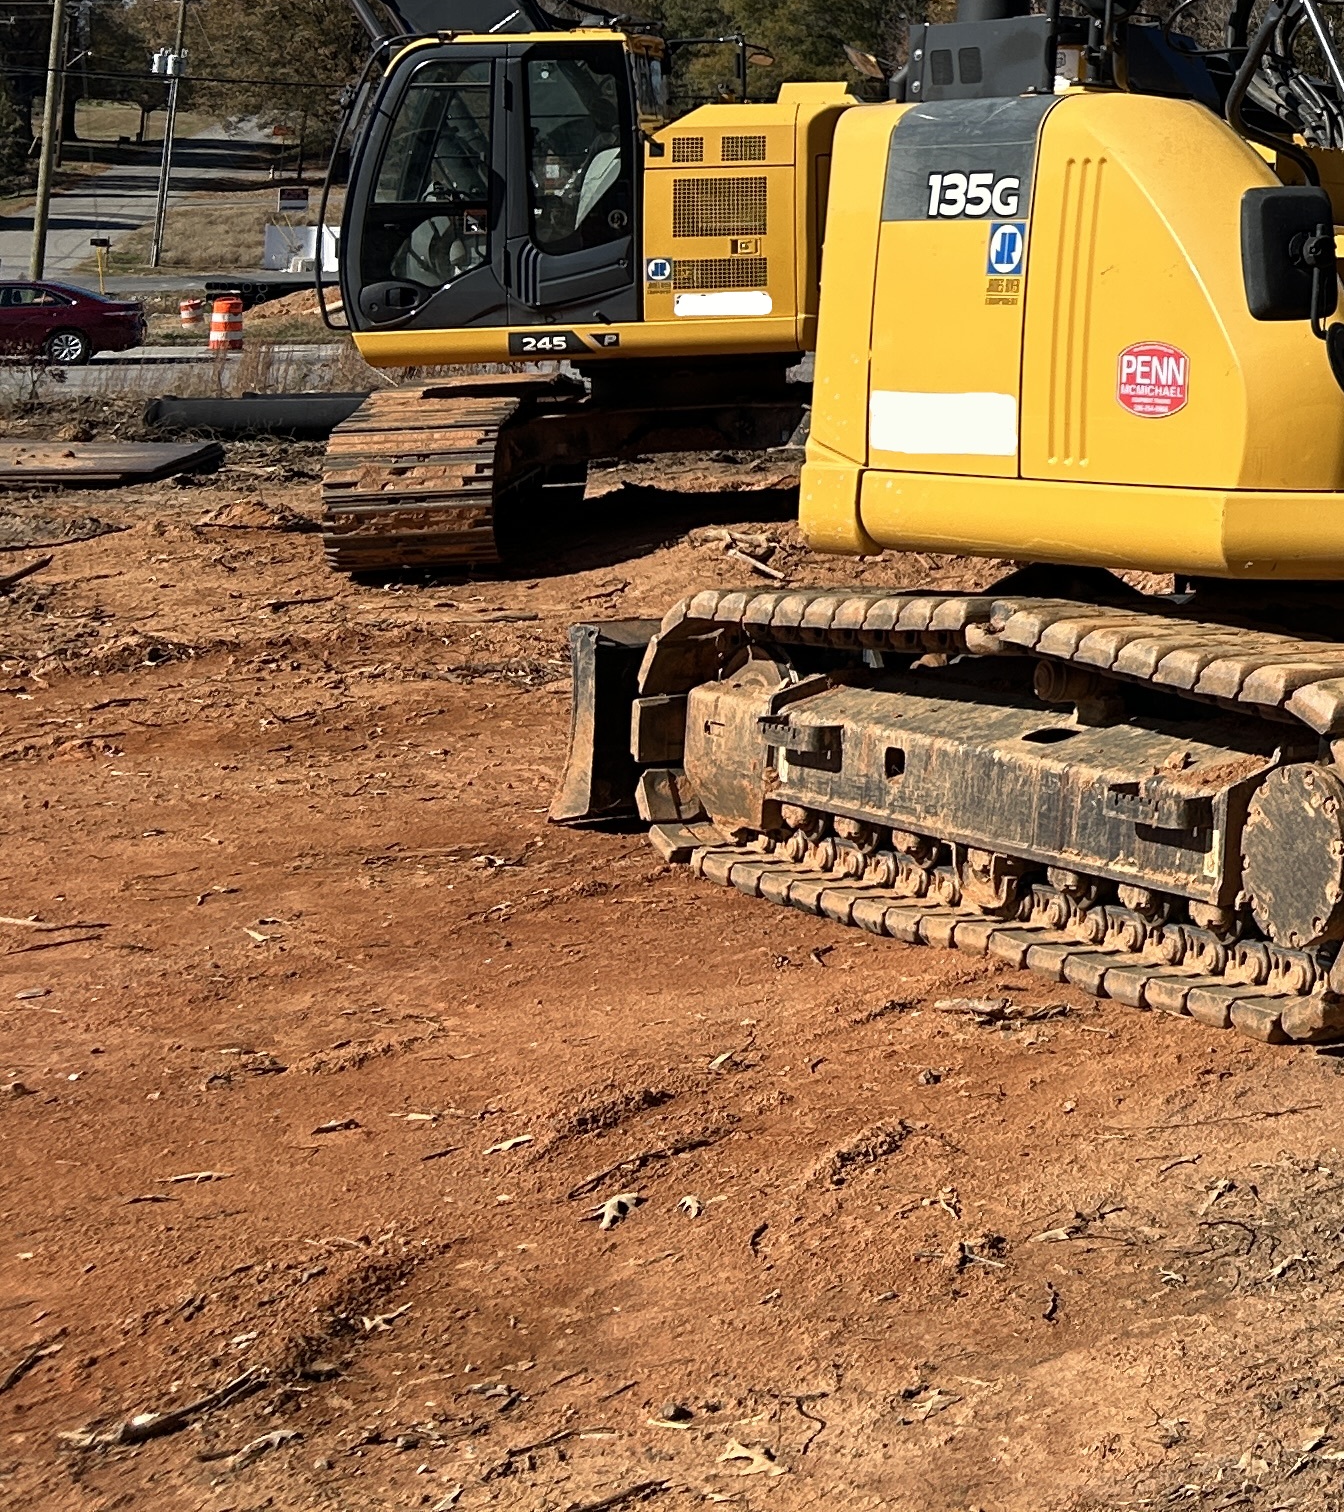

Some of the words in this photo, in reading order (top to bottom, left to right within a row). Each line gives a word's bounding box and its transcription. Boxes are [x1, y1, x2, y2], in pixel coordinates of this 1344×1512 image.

[928, 172, 1020, 216] 135G
[522, 335, 567, 352] 245
[603, 334, 617, 347] P
[1121, 355, 1184, 386] PENN
[1120, 384, 1184, 398] MCMICHAEL
